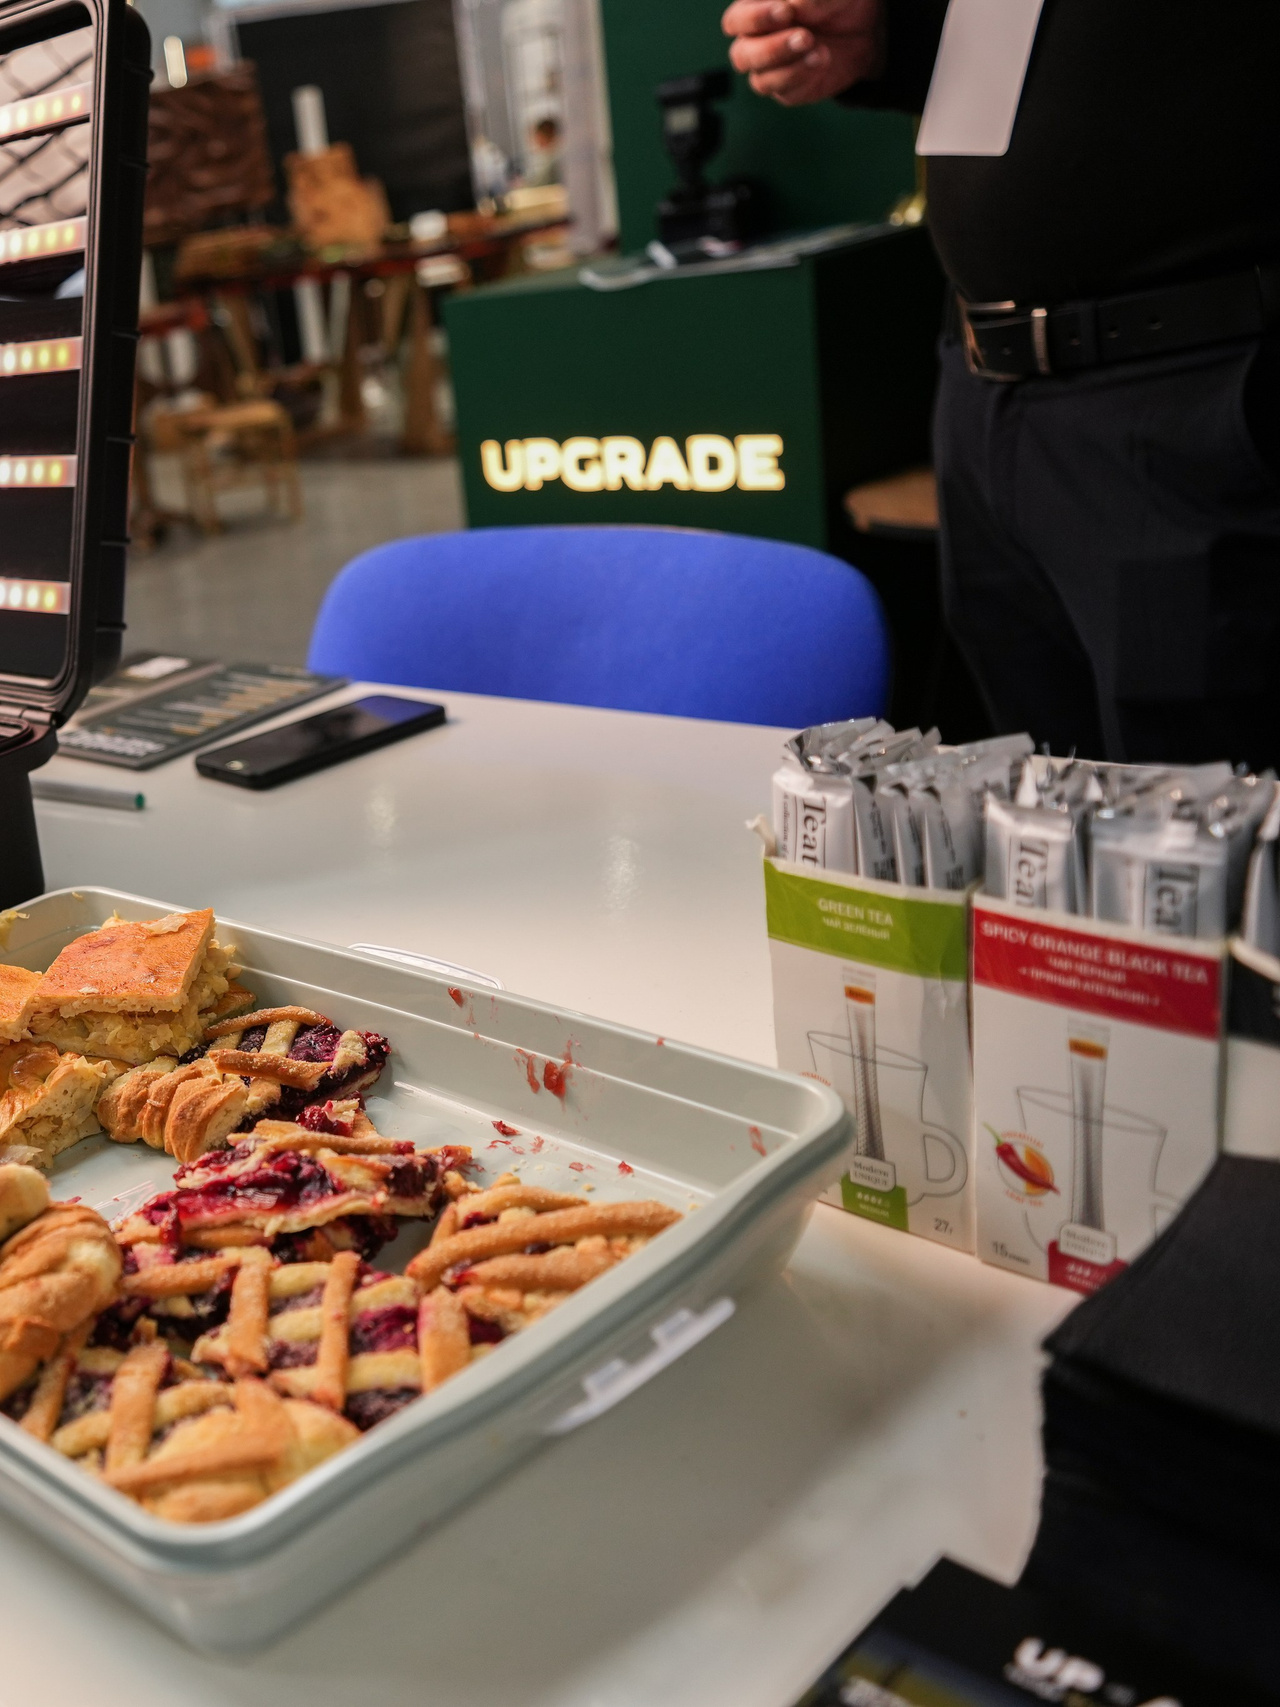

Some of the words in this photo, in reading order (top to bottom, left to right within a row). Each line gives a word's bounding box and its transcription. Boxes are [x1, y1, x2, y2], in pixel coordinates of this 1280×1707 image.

[480, 434, 785, 492] UPGRADE
[817, 898, 864, 919] GREEN
[869, 907, 894, 927] TEA
[1155, 863, 1200, 934] Tea
[980, 921, 1030, 945] SPICY
[1031, 934, 1105, 962] ORANGE
[1107, 946, 1169, 977] BLACK
[1173, 962, 1209, 985] TEA
